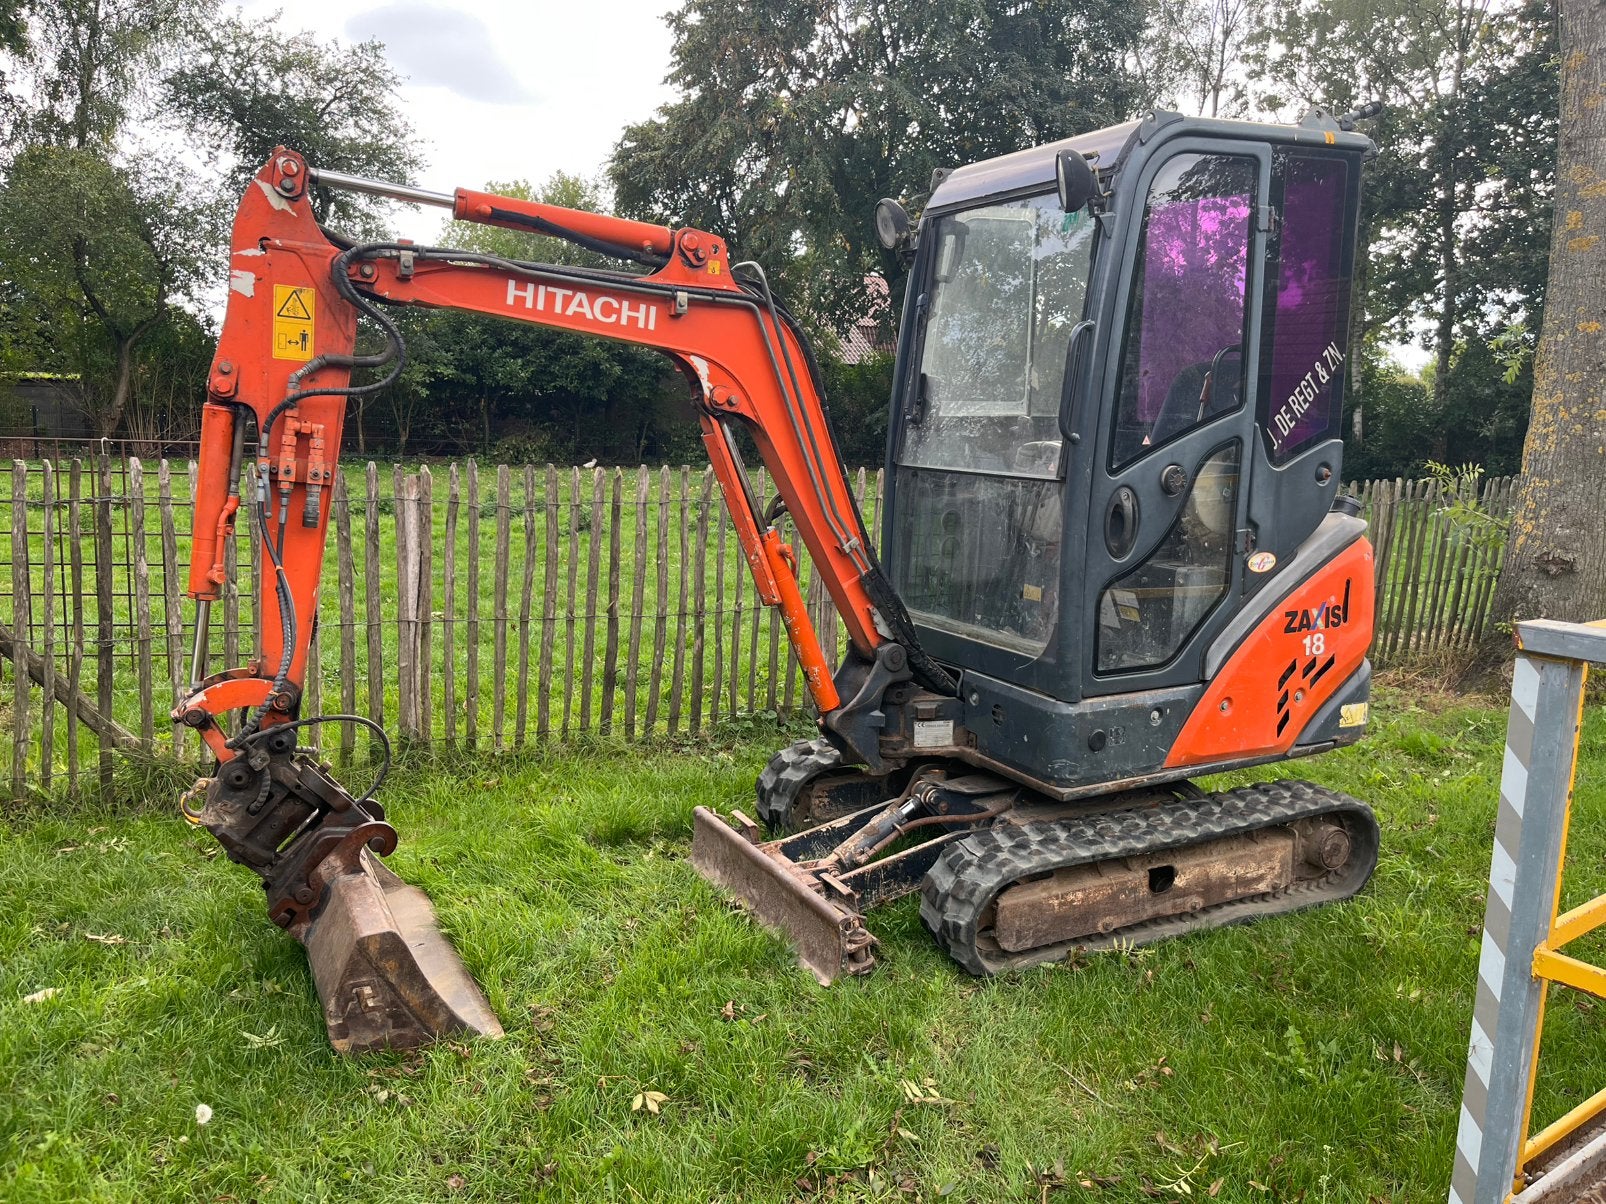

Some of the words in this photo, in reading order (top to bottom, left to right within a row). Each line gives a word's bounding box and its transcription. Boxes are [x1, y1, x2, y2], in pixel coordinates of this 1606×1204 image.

[506, 279, 656, 330] HITACHI
[1266, 427, 1282, 450] J.
[1274, 405, 1296, 437] DE
[1288, 371, 1319, 418] REGT
[1314, 361, 1330, 384] &
[1322, 341, 1346, 372] ZN.
[1284, 601, 1342, 633] ZAXIS
[1302, 633, 1325, 656] 18
